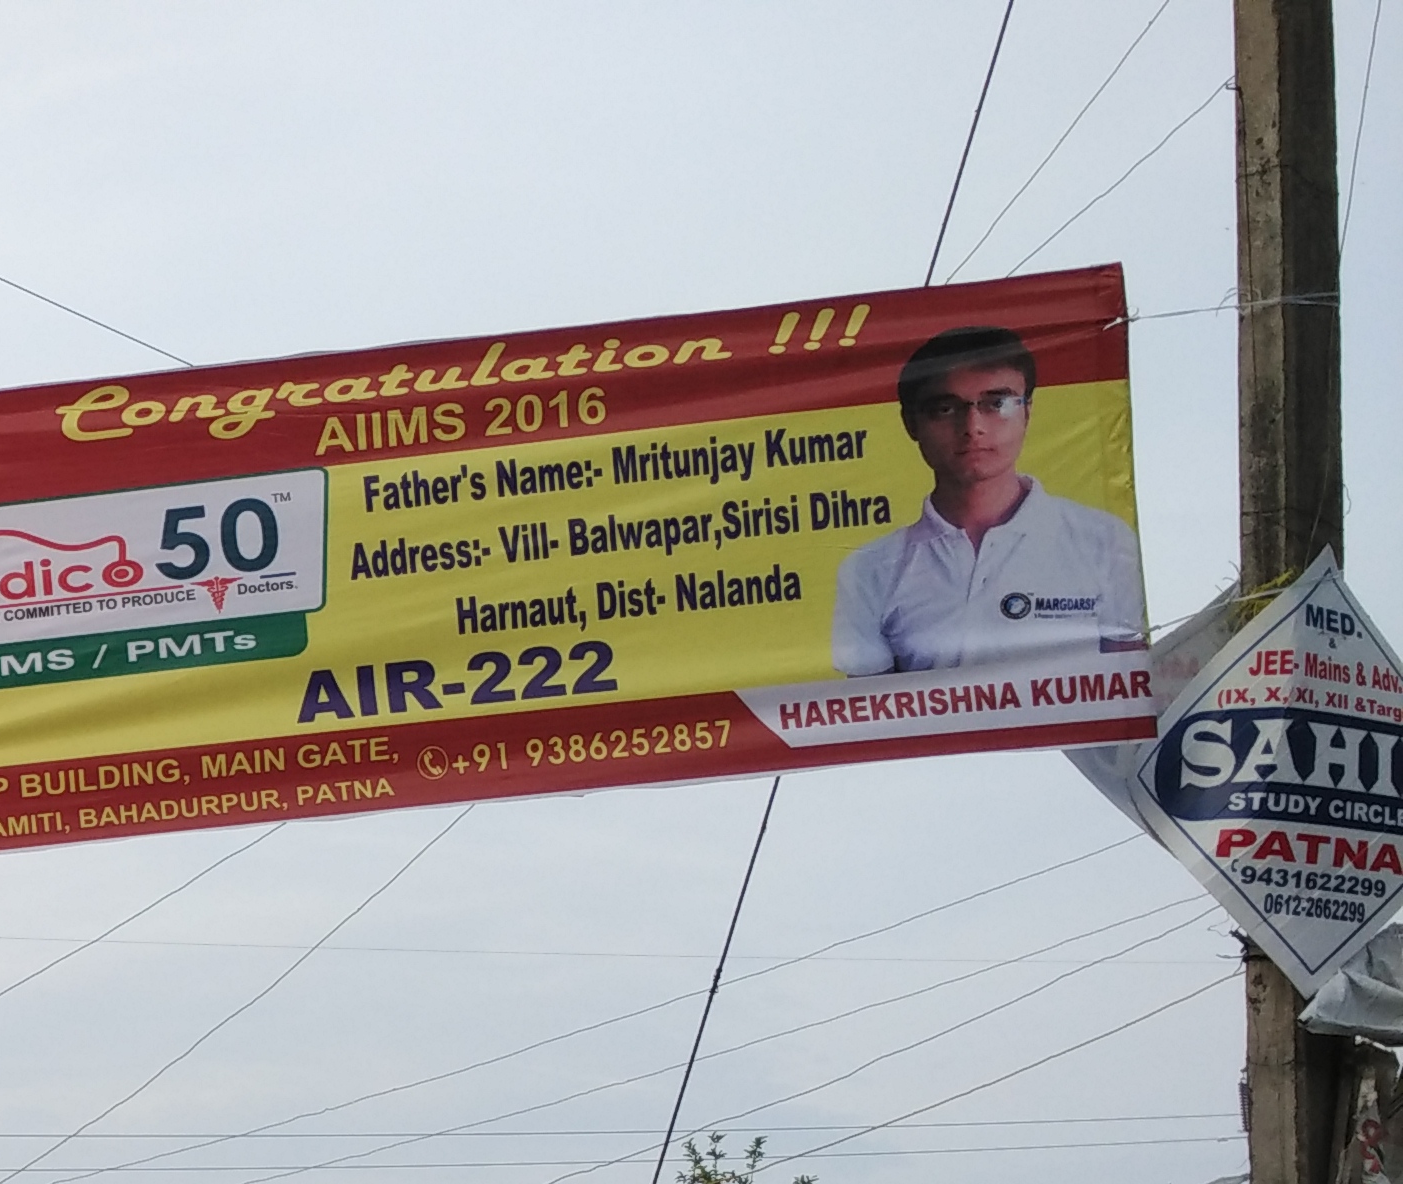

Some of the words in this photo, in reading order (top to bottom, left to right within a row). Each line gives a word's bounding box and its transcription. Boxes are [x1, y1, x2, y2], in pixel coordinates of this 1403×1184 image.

[56, 337, 732, 441] Congratulation
[768, 303, 871, 355] !!!
[314, 404, 467, 457] AIIMS
[484, 386, 608, 436] 2016
[363, 466, 487, 513] Father's
[495, 457, 603, 499] Name:-
[611, 436, 754, 489] Mritunjay
[765, 426, 867, 468] Kumar
[154, 497, 279, 580] 50
[350, 538, 491, 581] Address:-
[499, 522, 560, 565] Vill-
[569, 495, 799, 556] Balwapar,Sirisi
[809, 491, 891, 531] Dihra
[3, 600, 93, 623] COMMITTED
[96, 598, 118, 612] TO
[121, 588, 196, 610] PRODUCE
[237, 576, 298, 595] Doctors.
[455, 584, 587, 637] Harnaut,
[595, 577, 667, 621] Dist-
[675, 564, 802, 613] Nalanda
[1305, 604, 1362, 638] MED.
[126, 630, 257, 664] PMTs
[1329, 638, 1336, 648] &
[296, 639, 618, 724] AIR-222
[1249, 650, 1299, 676] JEE-
[1304, 652, 1350, 684] Mains
[1356, 662, 1366, 687] &
[1372, 665, 1402, 694] Adv.
[779, 684, 1020, 730] HAREKRISHNA
[1030, 670, 1153, 709] KUMAR
[1218, 688, 1256, 708] (IX,
[1264, 686, 1288, 704] X,
[1295, 687, 1319, 708] XI,
[1325, 691, 1348, 709] XII
[1355, 697, 1403, 722] &Targ
[20, 759, 191, 797] BUILDING,
[200, 748, 286, 781] MAIN
[296, 736, 400, 768] GATE,
[450, 740, 510, 774] +91
[525, 720, 732, 767] 9386252857
[1180, 718, 1403, 798] SAHI
[78, 787, 289, 831] BAHADURPUR,
[296, 777, 394, 806] PATNA
[1228, 791, 1322, 815] STUDY
[1329, 799, 1403, 826] CIRCLE
[1215, 828, 1403, 875] PATNA
[1241, 865, 1386, 898] 9431622299
[1264, 893, 1365, 923] 0612-2662299
